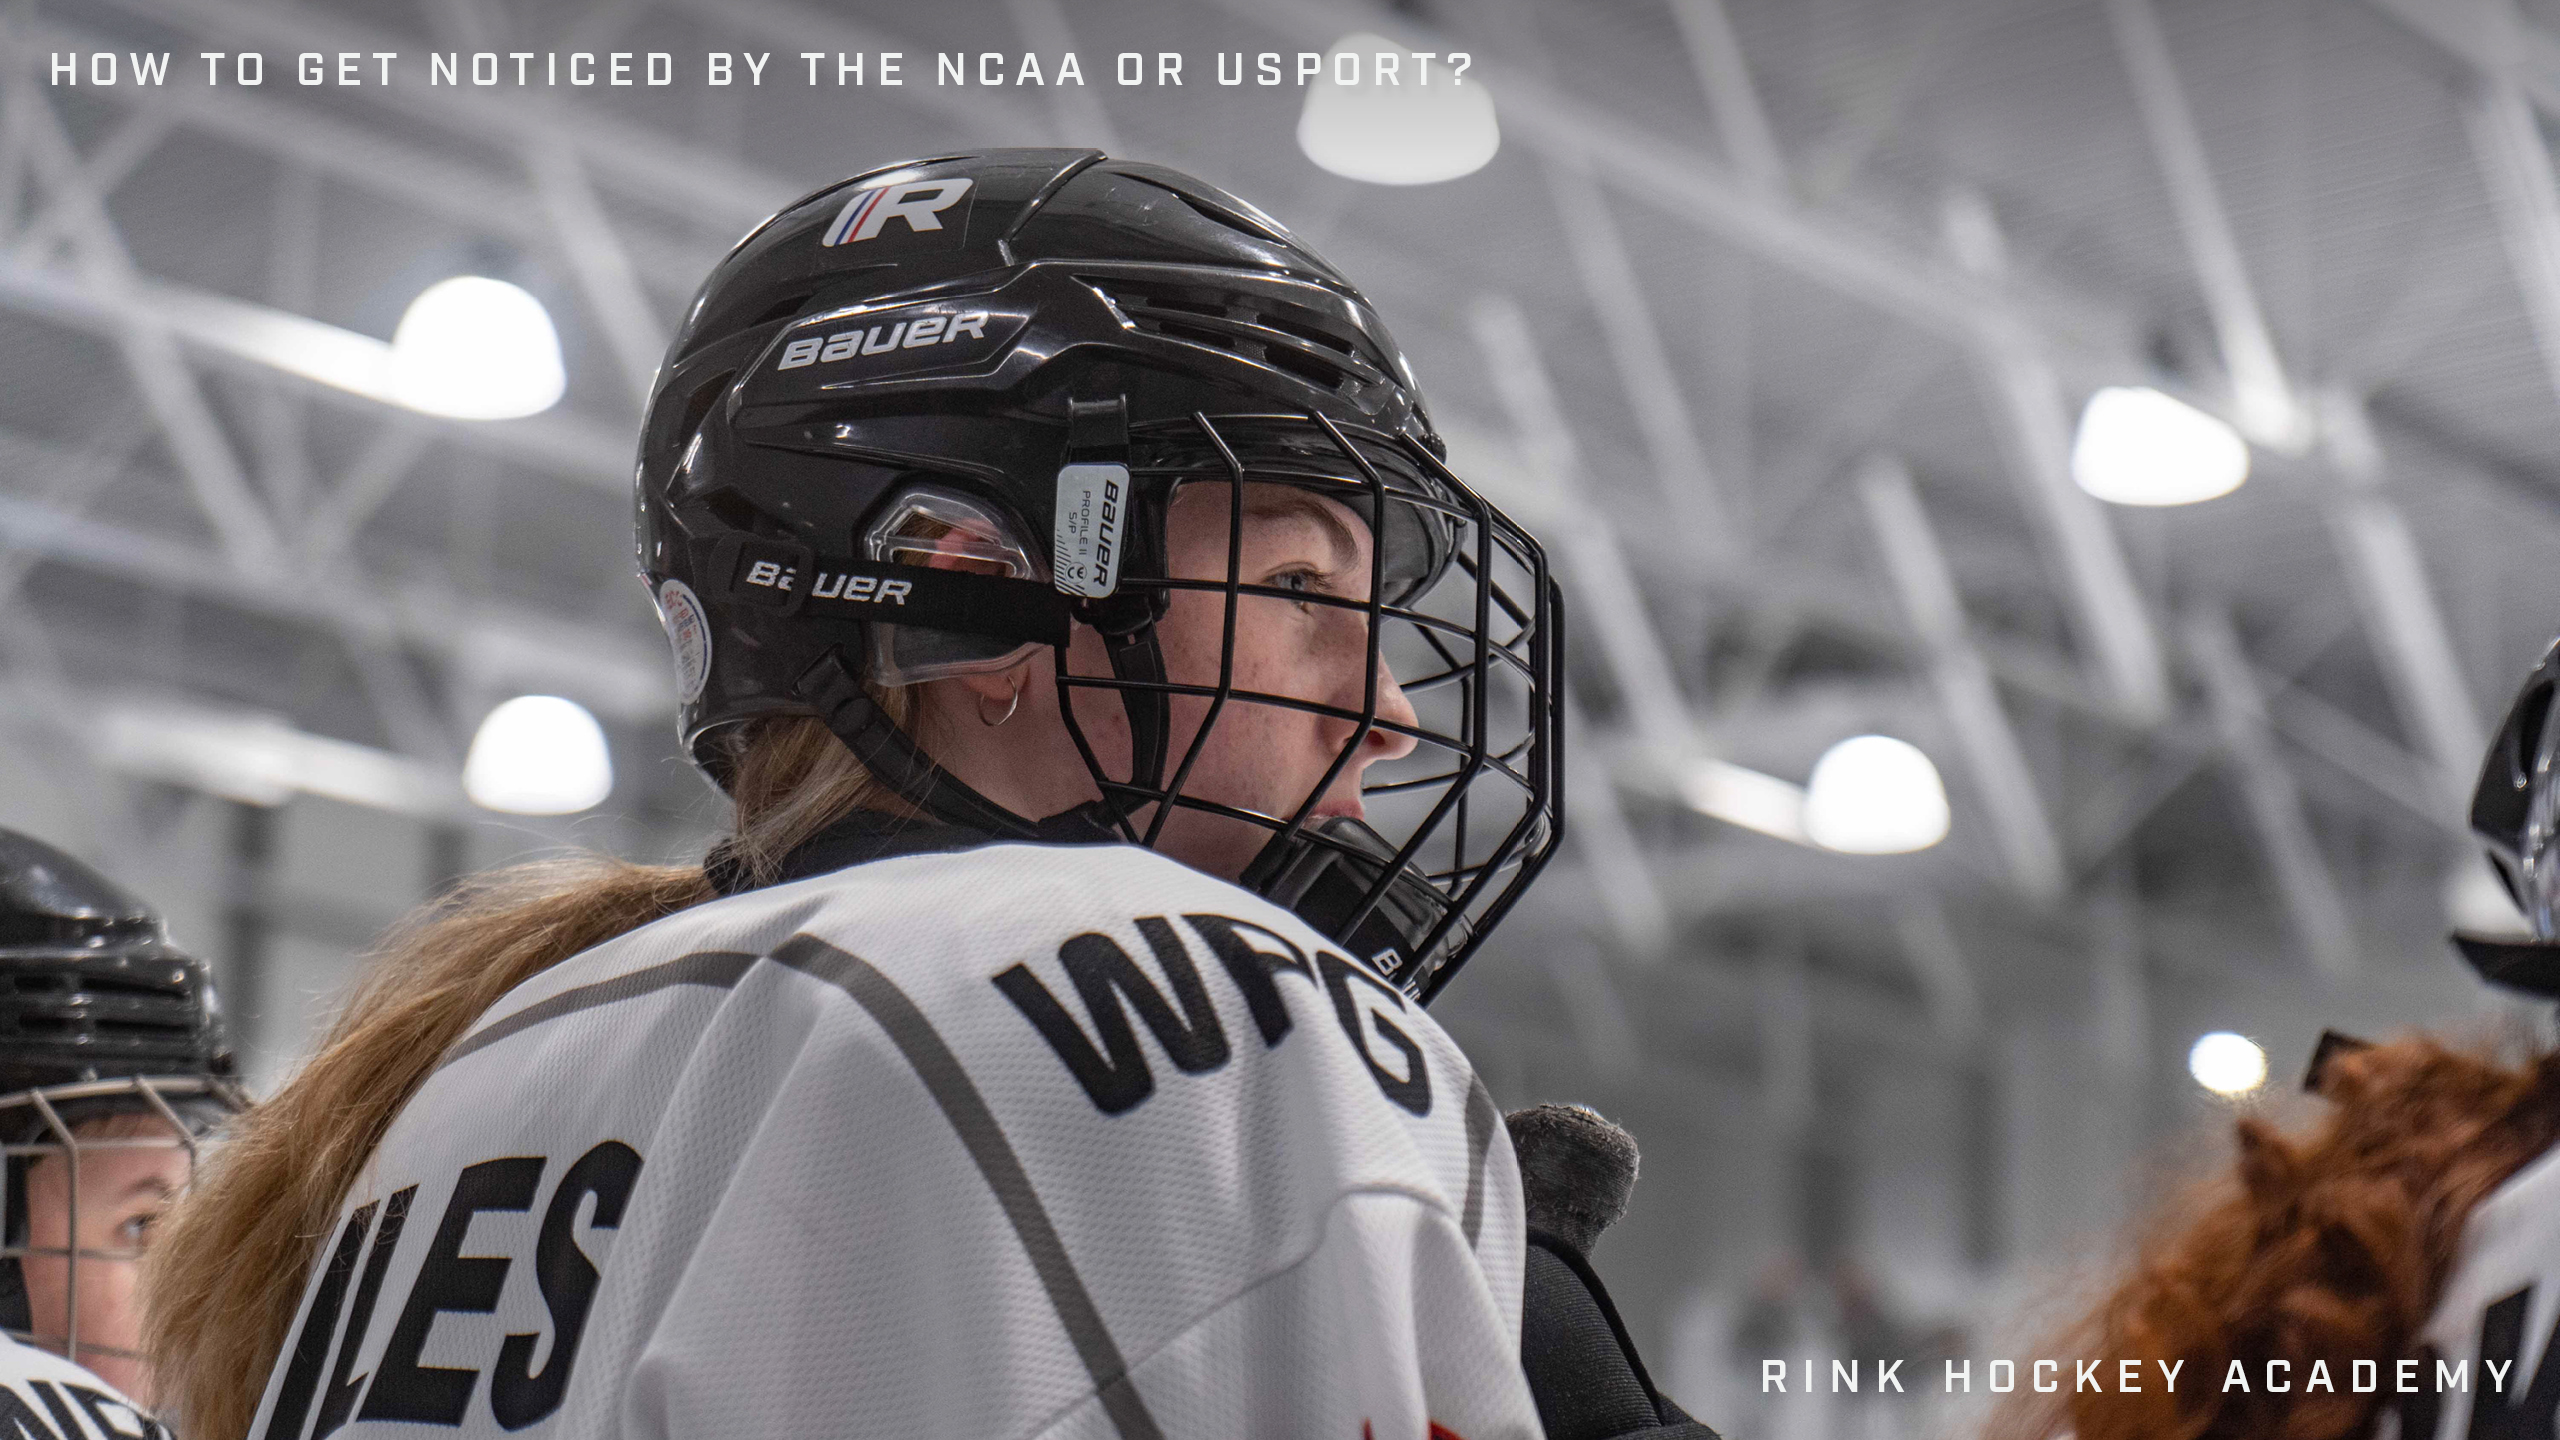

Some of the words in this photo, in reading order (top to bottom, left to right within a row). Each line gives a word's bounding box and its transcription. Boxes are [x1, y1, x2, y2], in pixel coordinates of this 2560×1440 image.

[1068, 511, 1078, 534] S/P
[1079, 490, 1091, 545] PROFILE
[992, 914, 1432, 1118] WPG
